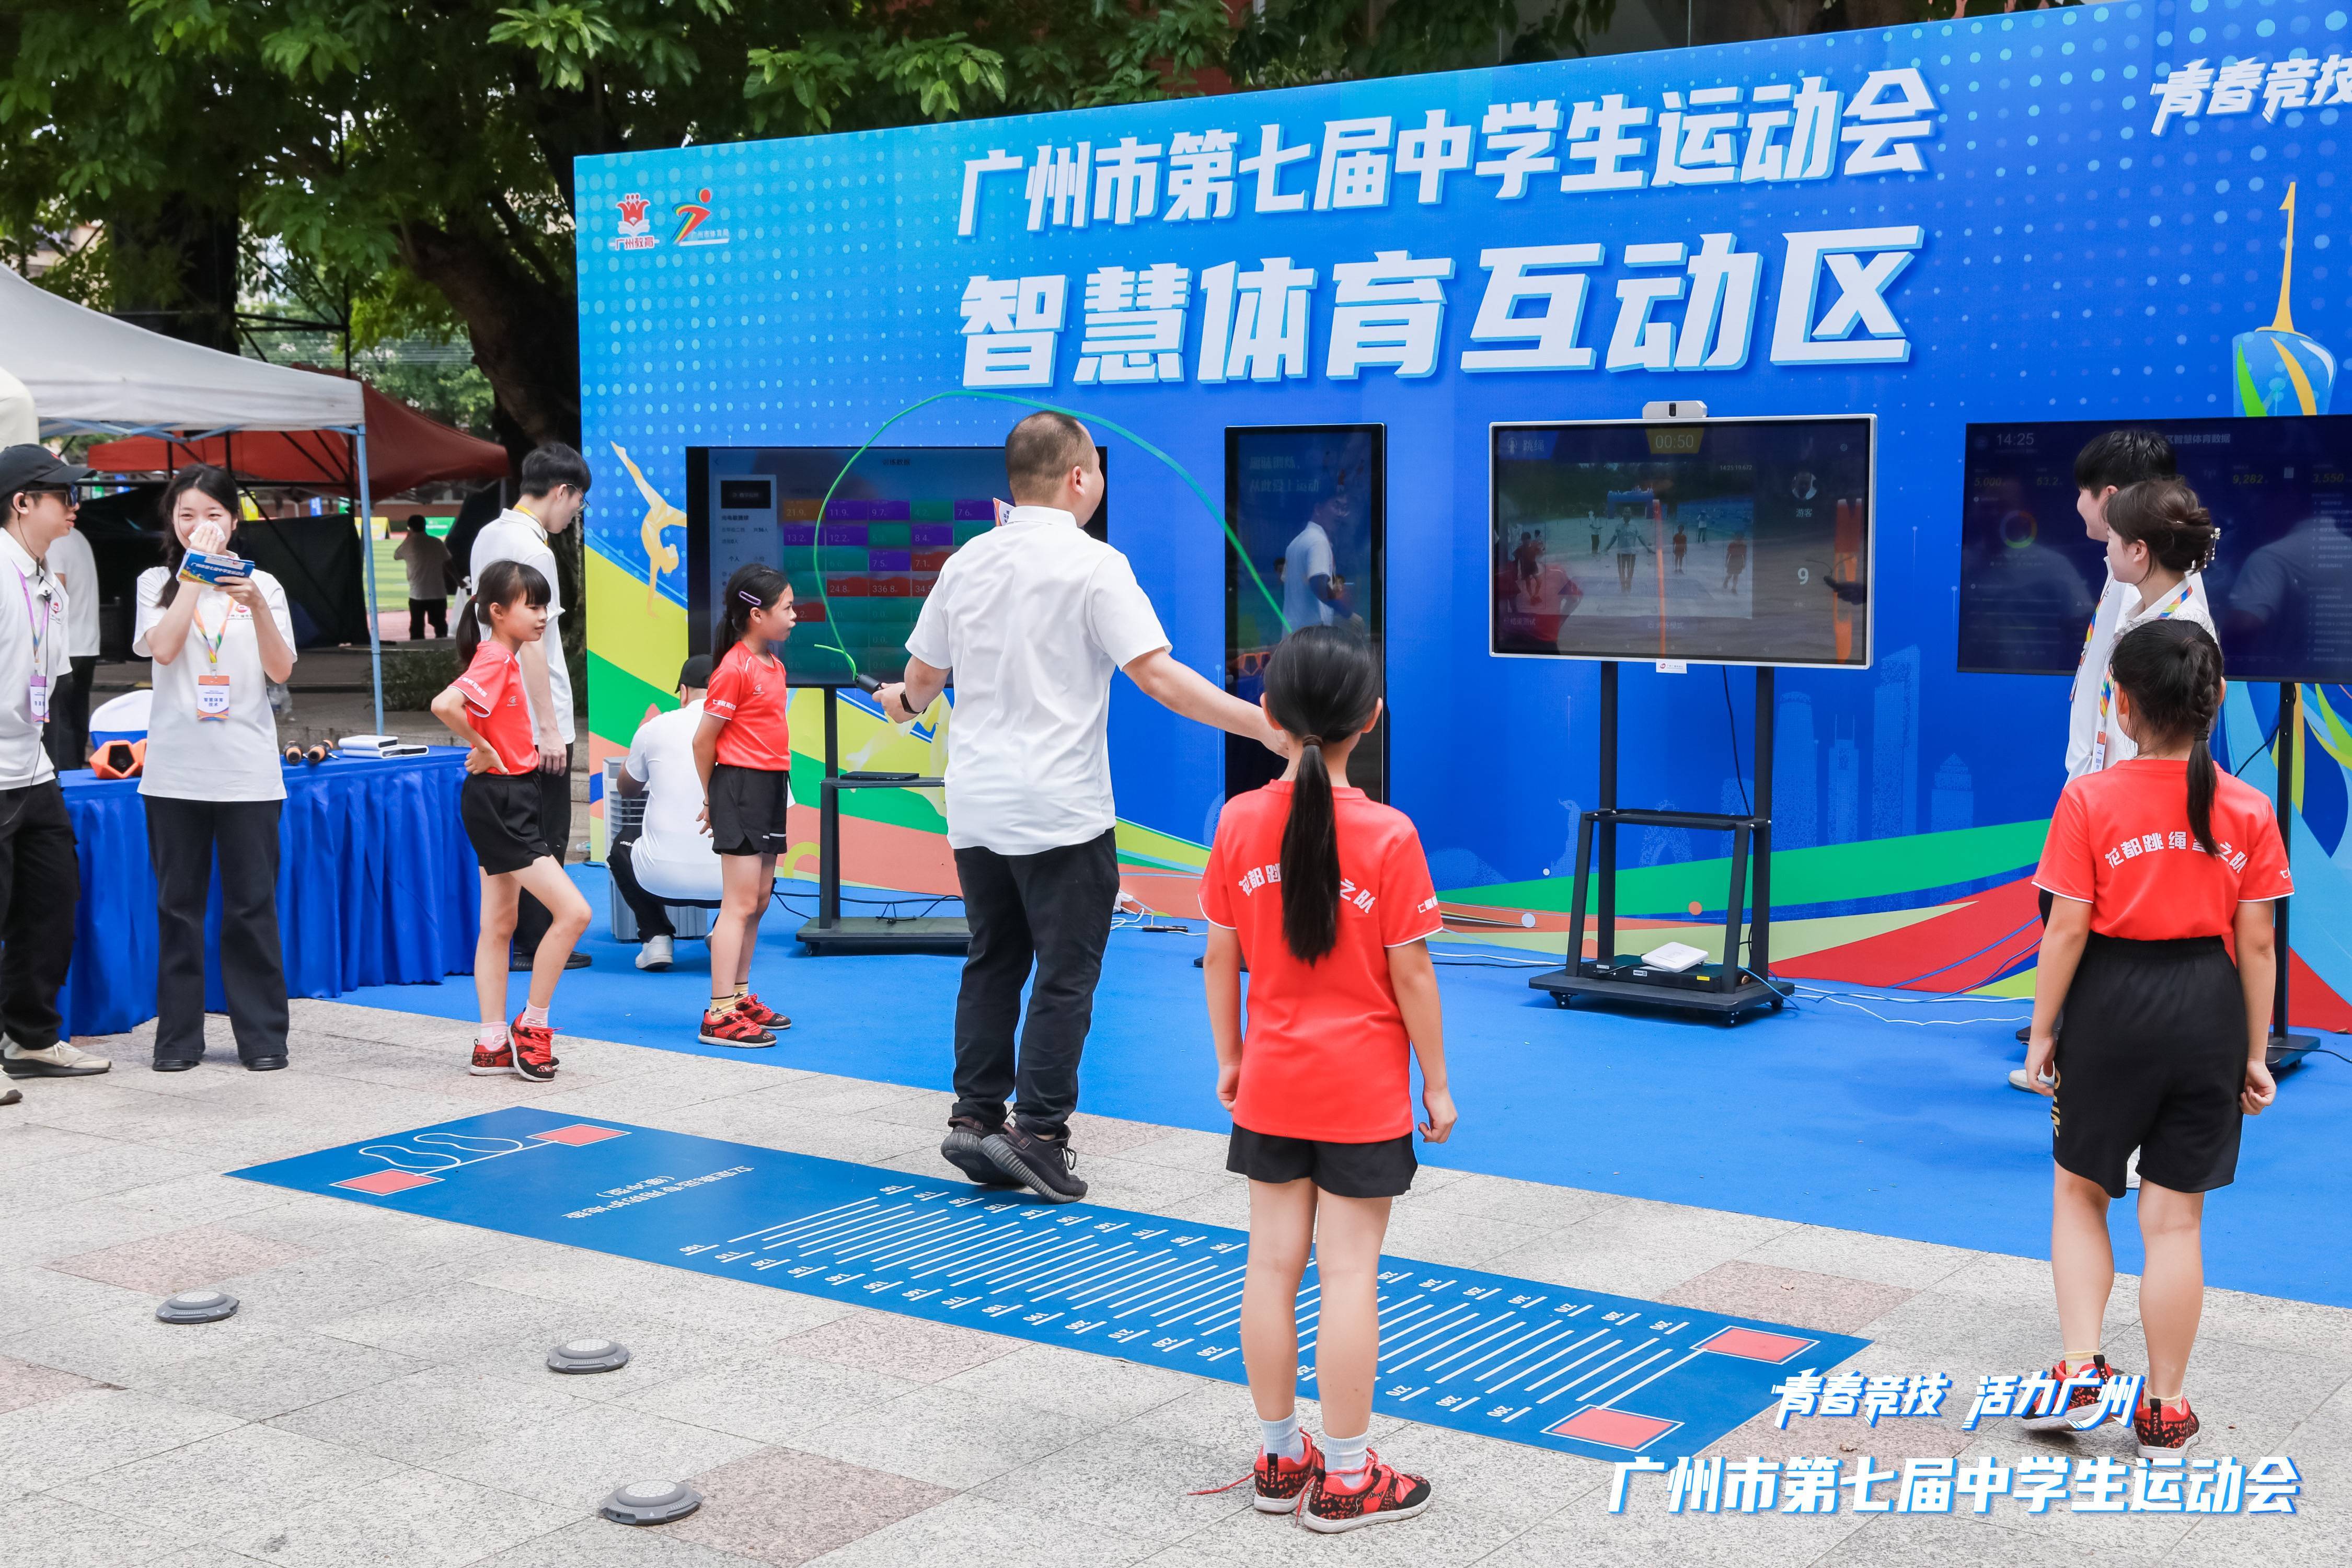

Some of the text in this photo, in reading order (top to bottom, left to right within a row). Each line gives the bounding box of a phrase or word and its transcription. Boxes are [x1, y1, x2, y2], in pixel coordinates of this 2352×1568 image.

[958, 67, 1937, 237] 广州市第七届中学生运动会
[615, 237, 654, 249] 广州教育
[959, 225, 1924, 388] 智慧体育互动区
[1655, 434, 1694, 449] 00:50
[1997, 433, 2034, 446] 14:25
[1521, 439, 1544, 452] 跳绳
[2232, 474, 2264, 485] 9,282
[2312, 474, 2344, 483] 3,550
[1249, 478, 1319, 493] 从此爱上运动
[1796, 508, 1813, 517] 游客
[829, 534, 847, 543] 12.2
[1797, 567, 1809, 585] 9
[561, 1166, 755, 1218] 立定跳远专用防护地垫
[679, 1244, 705, 1252] 100
[714, 1251, 740, 1260] 110
[751, 1259, 776, 1267] 120
[787, 1266, 813, 1274] 130
[824, 1273, 850, 1282] 140
[1377, 1271, 1398, 1280] 230
[863, 1281, 889, 1290] 150
[1418, 1278, 1442, 1288] 240
[902, 1288, 927, 1297] 160
[1462, 1287, 1486, 1296] 250
[941, 1296, 967, 1305] 170
[1507, 1295, 1531, 1304] 260
[982, 1304, 1008, 1313] 180
[1554, 1303, 1577, 1313] 270
[1023, 1312, 1049, 1322] 190
[1601, 1311, 1624, 1321] 280
[1065, 1320, 1091, 1330] 200
[1649, 1320, 1673, 1331] 290
[1108, 1329, 1134, 1339] 210
[1151, 1338, 1178, 1347] 220
[1196, 1346, 1223, 1356] 230
[1297, 1365, 1316, 1376] 25
[2100, 1368, 2109, 1385] HEAL
[1385, 1385, 1412, 1397] 270
[1435, 1395, 1462, 1407] 280
[1486, 1405, 1514, 1417] 290
